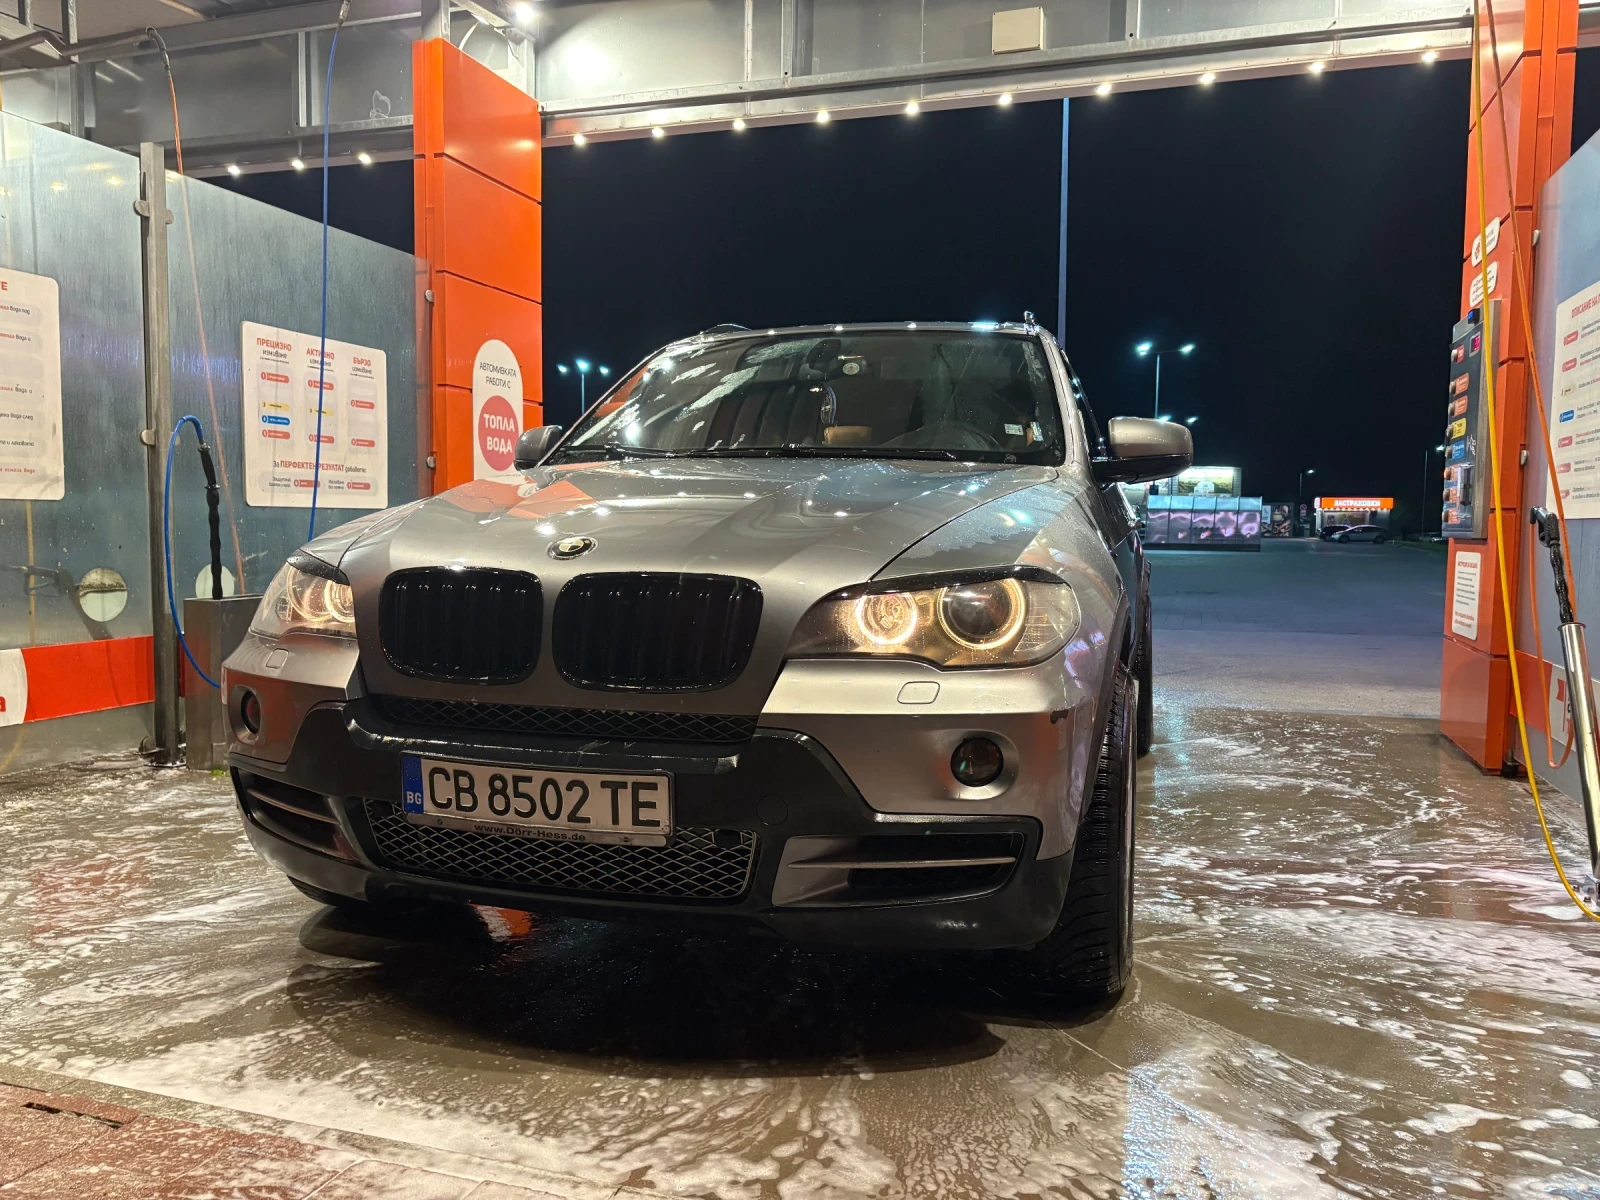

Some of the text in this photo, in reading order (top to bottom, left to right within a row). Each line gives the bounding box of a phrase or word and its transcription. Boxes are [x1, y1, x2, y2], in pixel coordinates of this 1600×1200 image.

[256, 337, 292, 352] ПРЕЦИЗНО
[352, 356, 372, 367] БЪРЗО
[479, 361, 517, 378] АВТОМИВКАТА
[485, 375, 507, 389] РАБОТИ
[483, 413, 515, 432] ТОПЛА
[486, 436, 513, 454] ВОДА
[406, 766, 660, 827] BG CB 8502 TE
[474, 824, 586, 841] www.Dörr-Hess.de
